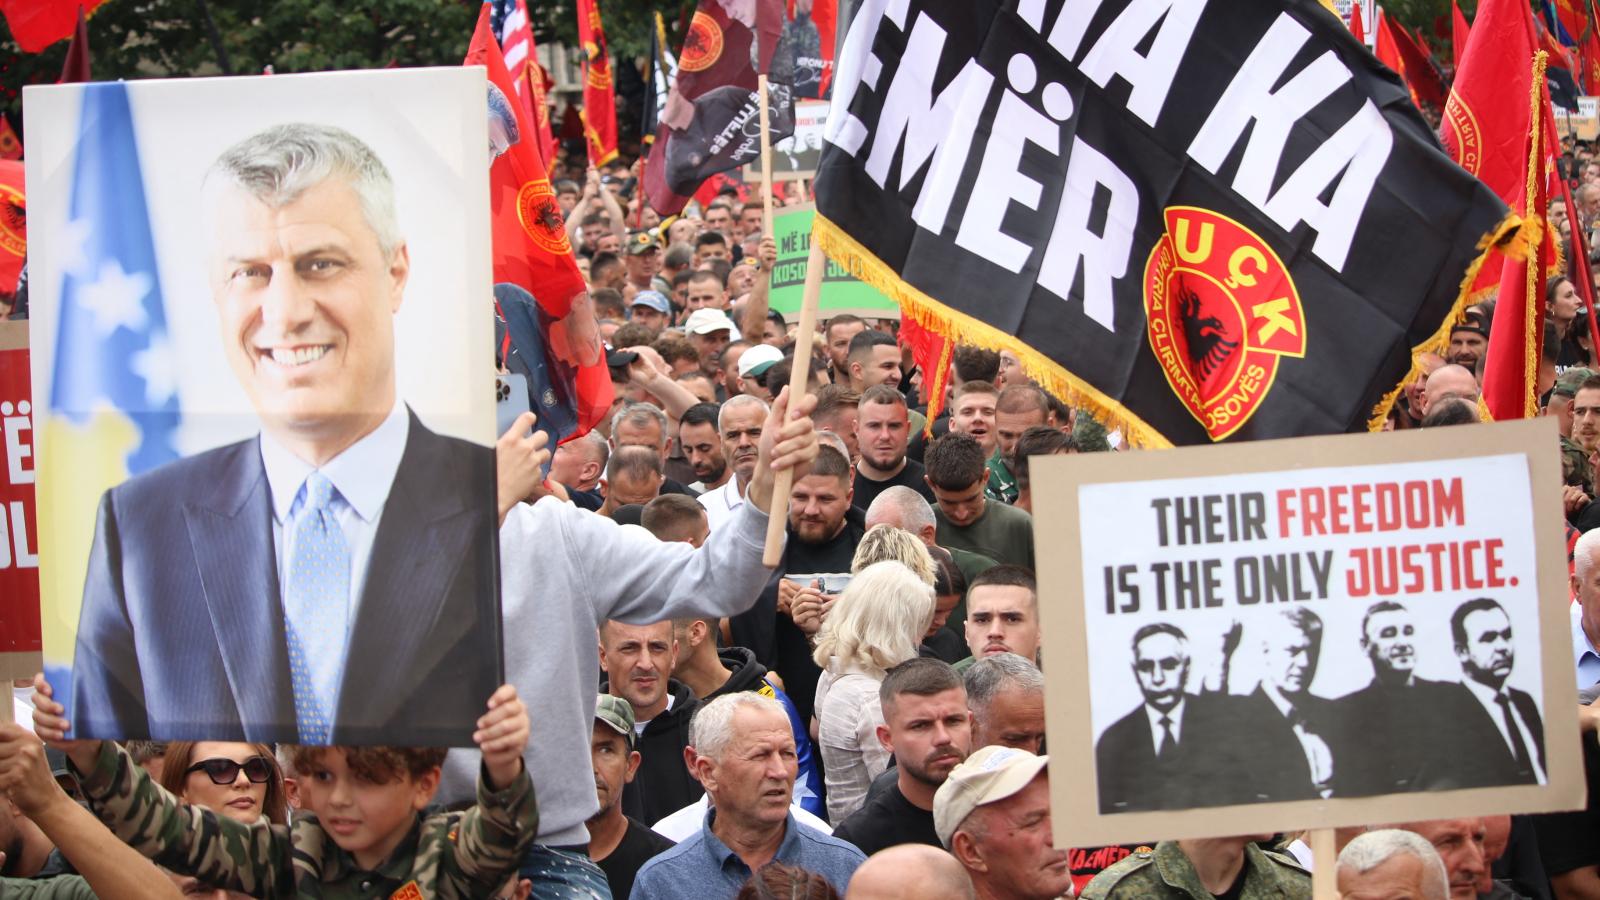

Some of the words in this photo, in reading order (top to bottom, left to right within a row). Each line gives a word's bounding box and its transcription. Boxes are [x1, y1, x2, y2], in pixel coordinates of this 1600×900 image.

[823, 0, 1140, 333] EMËR
[1186, 11, 1393, 273] KA
[773, 260, 811, 284] KOSO
[1175, 218, 1298, 346] UÇK
[1207, 364, 1265, 430] OSOVËS
[1151, 491, 1267, 547] THEIR
[1277, 477, 1465, 538] FREEDOM
[1103, 564, 1140, 615] IS
[1151, 558, 1223, 611] THE
[1234, 550, 1334, 606] ONLY
[1346, 538, 1519, 597] JUSTICE.
